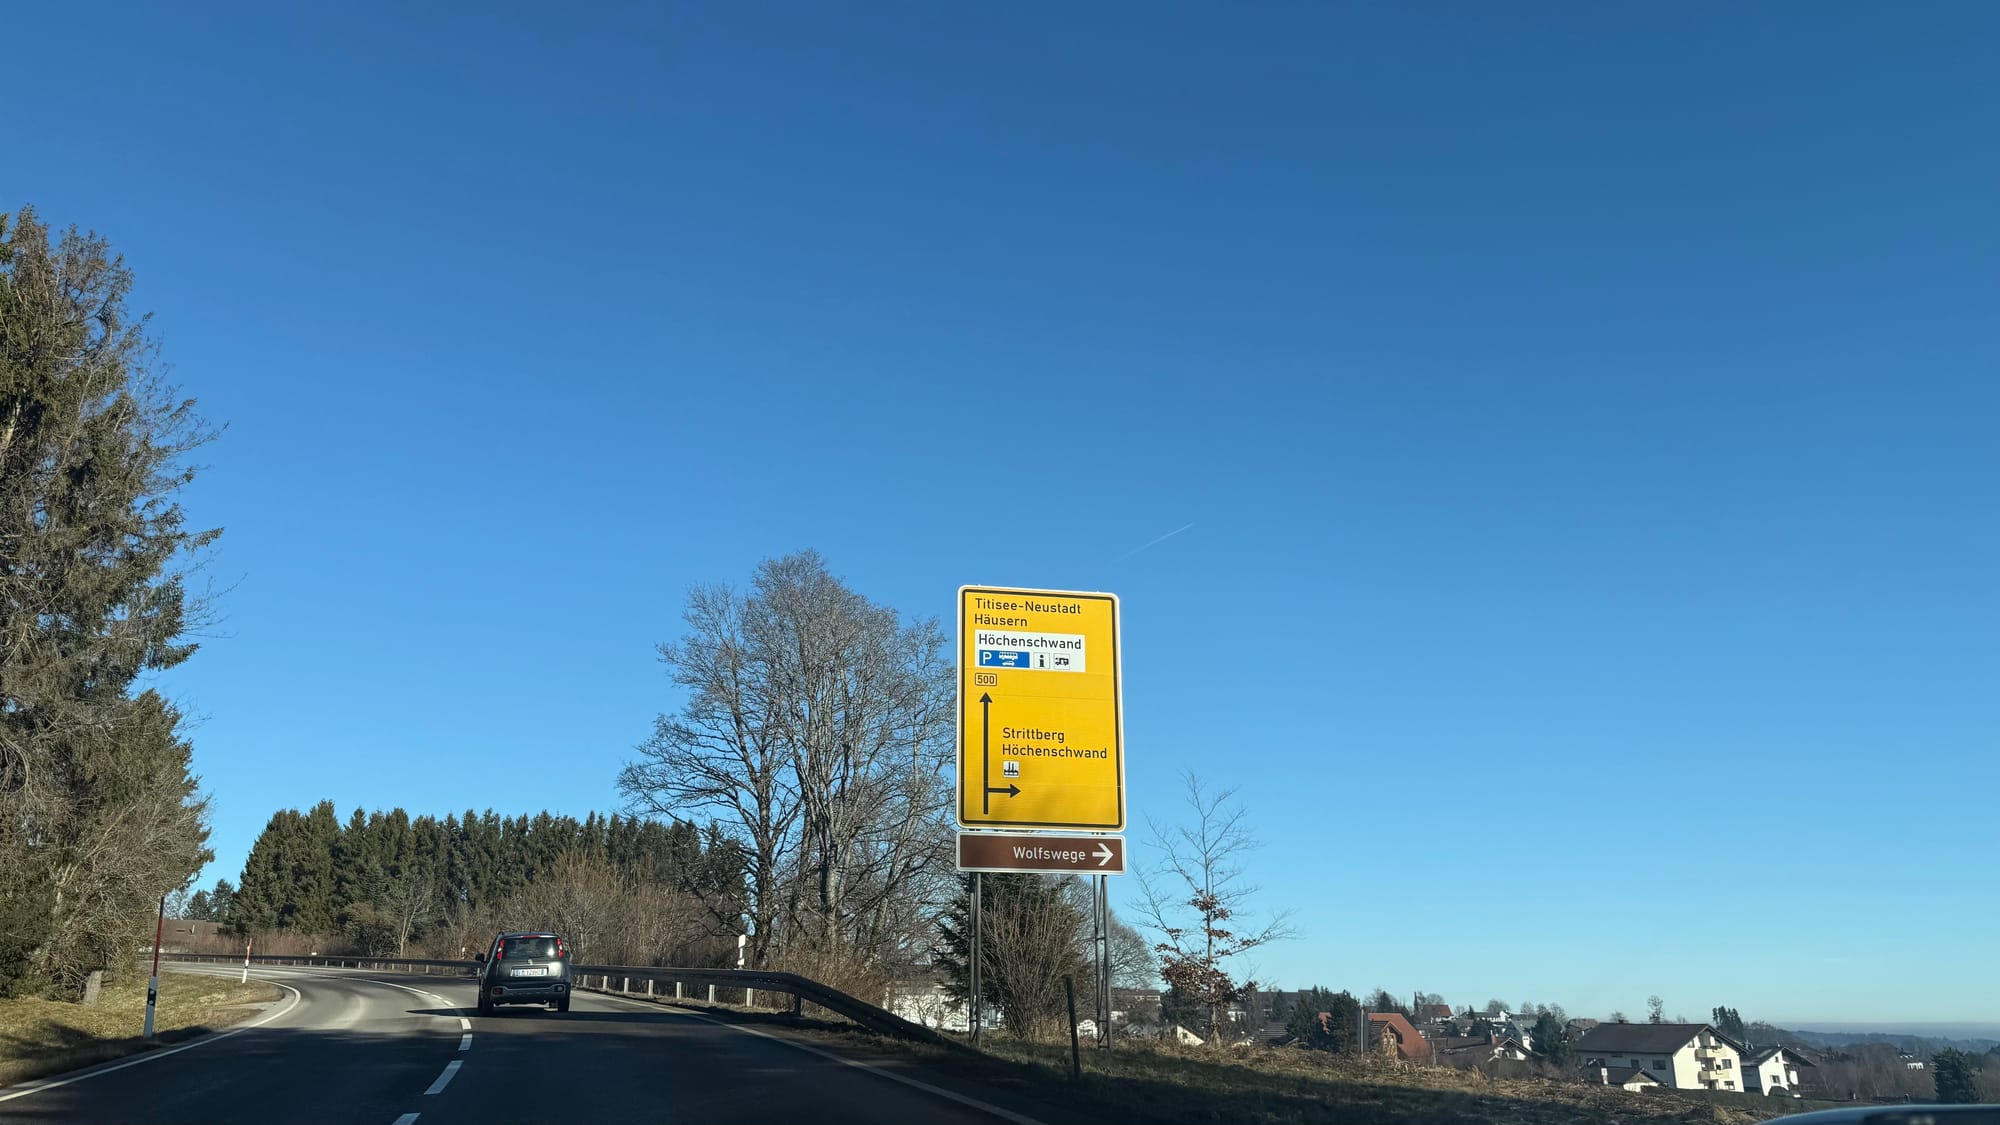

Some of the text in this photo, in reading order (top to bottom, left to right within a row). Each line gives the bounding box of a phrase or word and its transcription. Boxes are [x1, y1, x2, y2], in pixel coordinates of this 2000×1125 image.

[975, 598, 1081, 614] Titisee-Neustadt
[974, 613, 1028, 627] Häusern
[978, 633, 1082, 650] Höchenschwand
[977, 675, 995, 685] 500
[1002, 727, 1065, 744] Strittberg
[1002, 743, 1108, 759] Höchenschwand
[1013, 846, 1086, 864] Wolfswege
